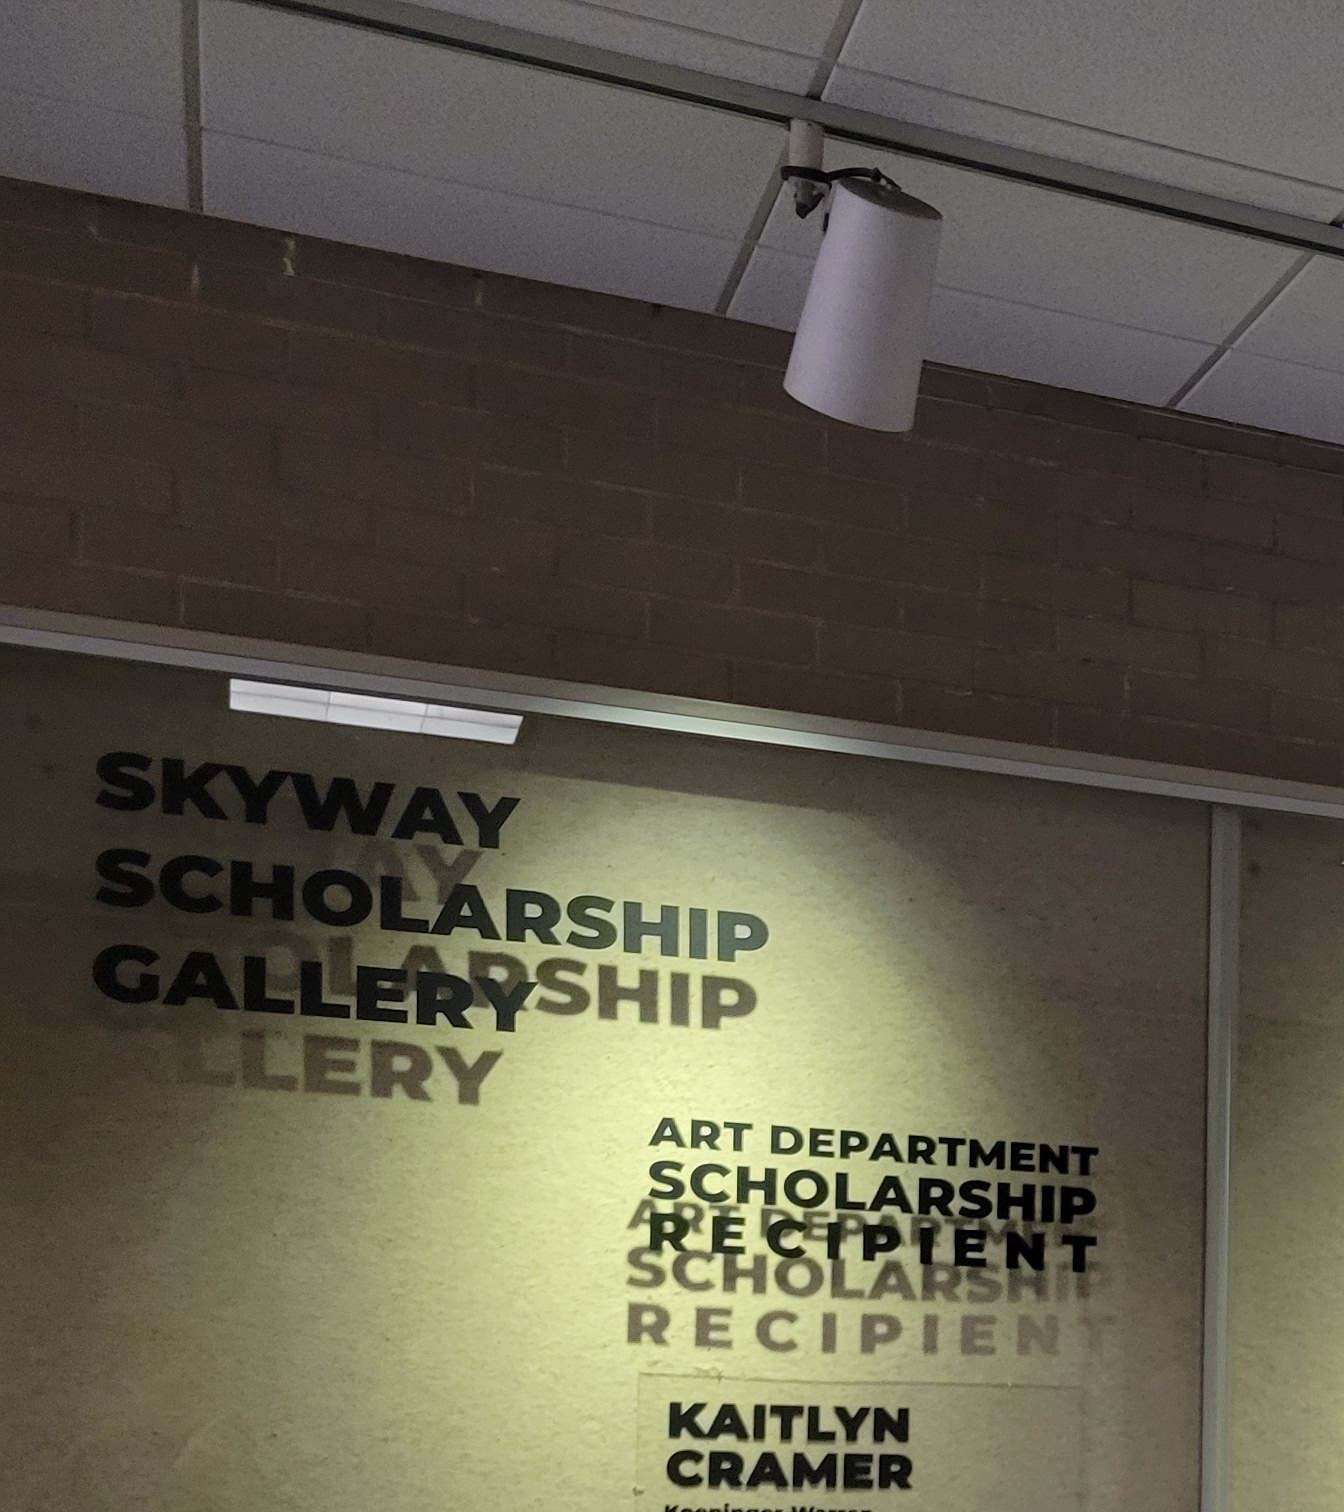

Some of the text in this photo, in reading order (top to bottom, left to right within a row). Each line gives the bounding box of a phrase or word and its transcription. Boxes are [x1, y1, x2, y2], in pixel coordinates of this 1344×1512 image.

[94, 750, 521, 849] SKYWAY
[94, 847, 770, 963] SCHOLARSHIP
[92, 943, 539, 1033] GALLERY
[648, 1117, 1099, 1176] ART DEPARTMENT
[648, 1160, 1098, 1225] SCHOLARSHIP
[649, 1212, 1098, 1273] RECIPIENT
[668, 1402, 910, 1443] KAITLYN
[666, 1450, 913, 1490] CRAMER
